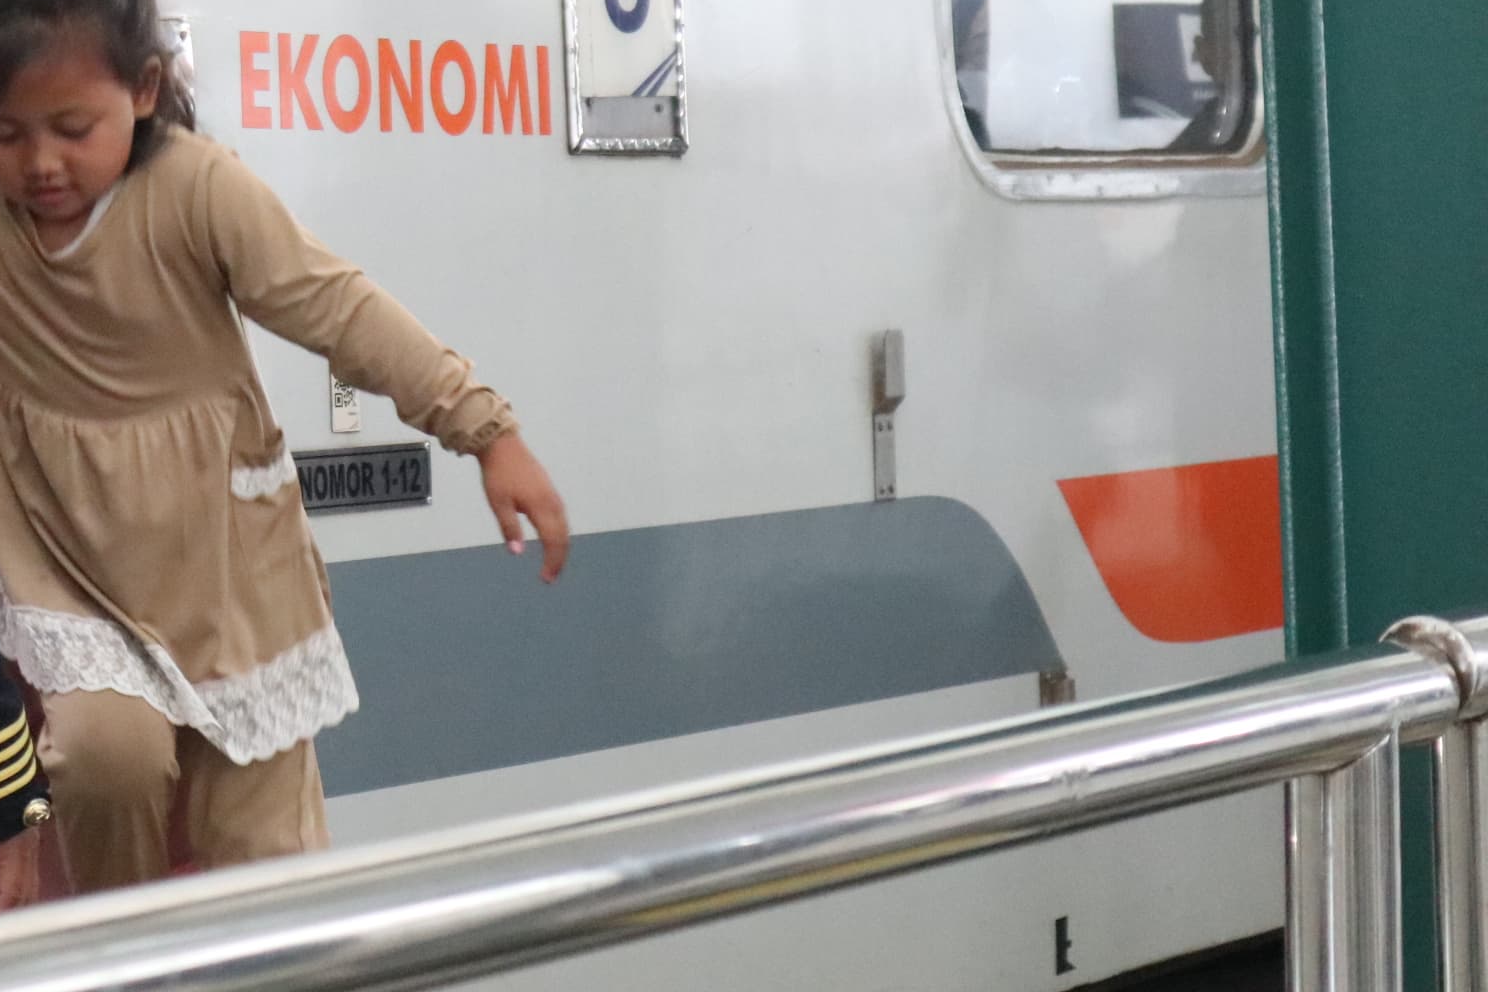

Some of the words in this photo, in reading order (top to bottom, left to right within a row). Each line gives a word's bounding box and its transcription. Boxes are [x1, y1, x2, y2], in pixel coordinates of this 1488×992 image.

[239, 30, 551, 137] EKONOMI
[298, 461, 375, 502] NOMOR
[382, 458, 422, 495] 1-12
